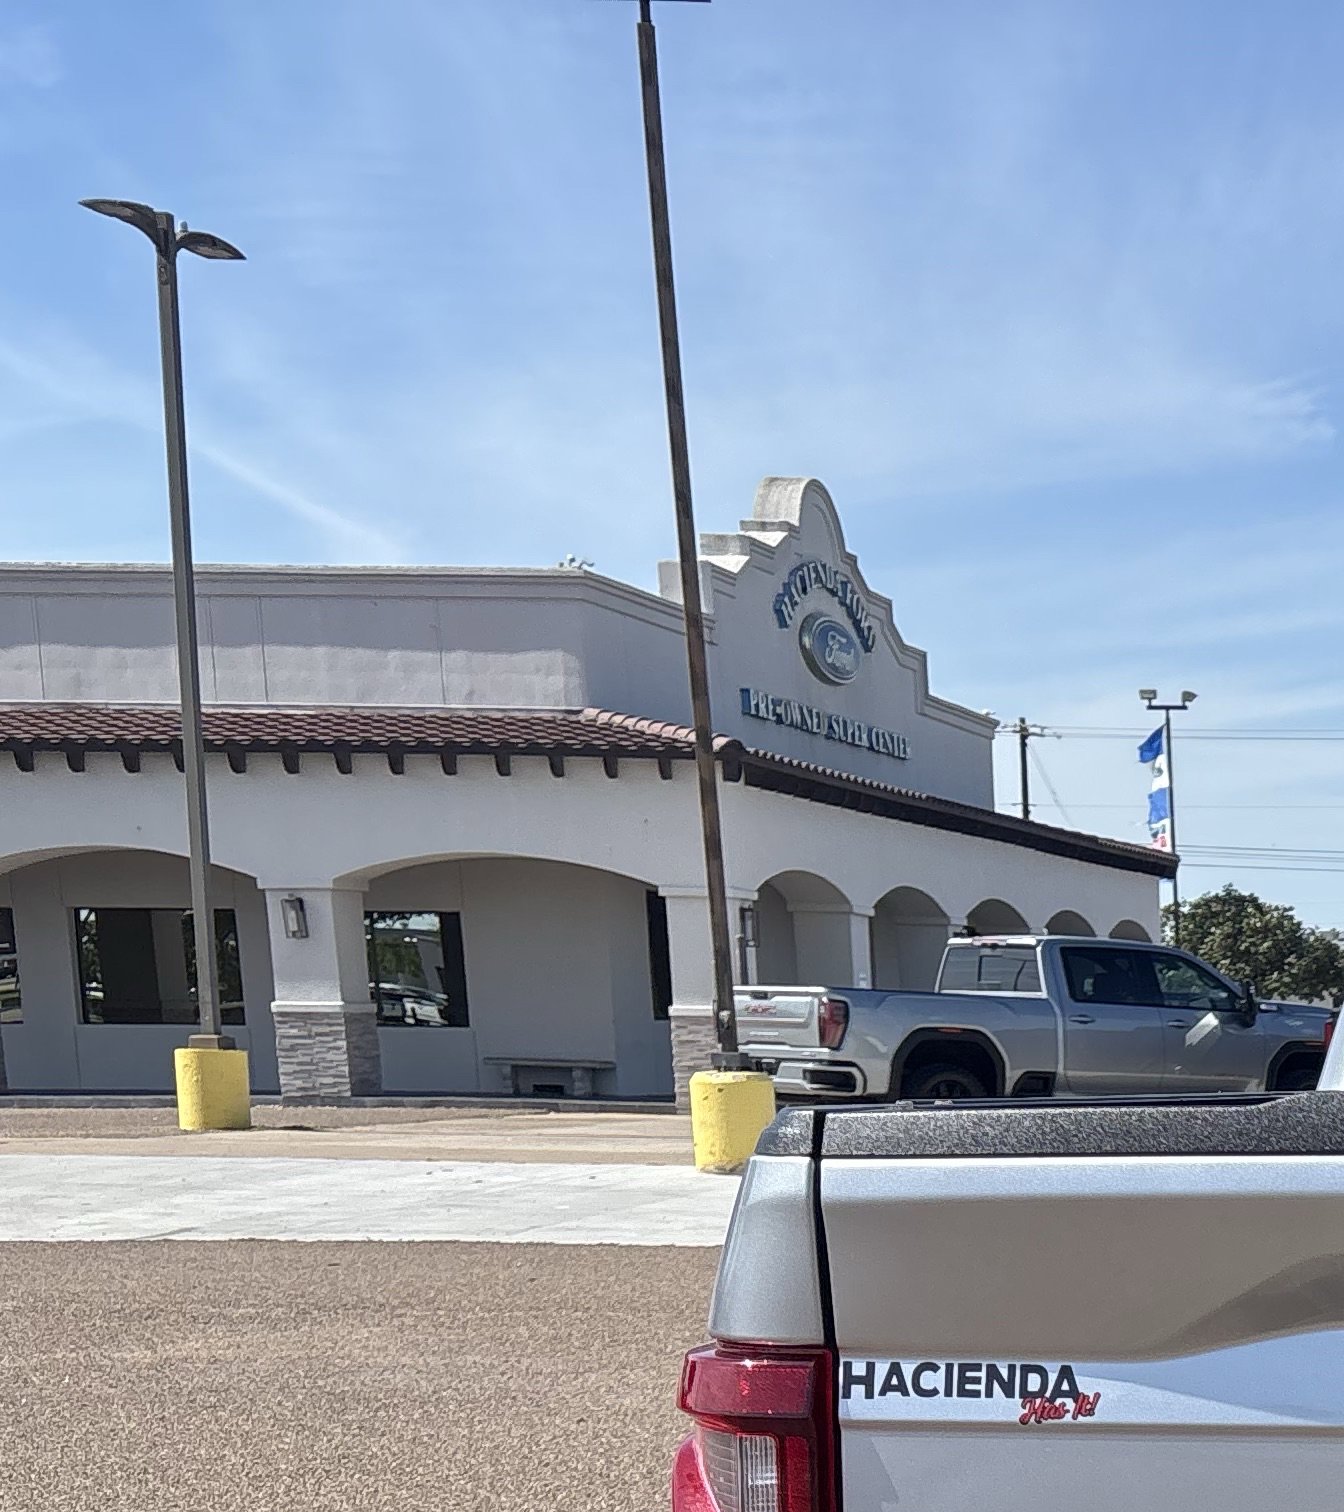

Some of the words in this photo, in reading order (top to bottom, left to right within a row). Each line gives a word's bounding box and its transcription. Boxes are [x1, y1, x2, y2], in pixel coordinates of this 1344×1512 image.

[841, 1360, 1080, 1401] HACIENDA
[1019, 1395, 1070, 1425] Has
[1071, 1391, 1102, 1420] It!
